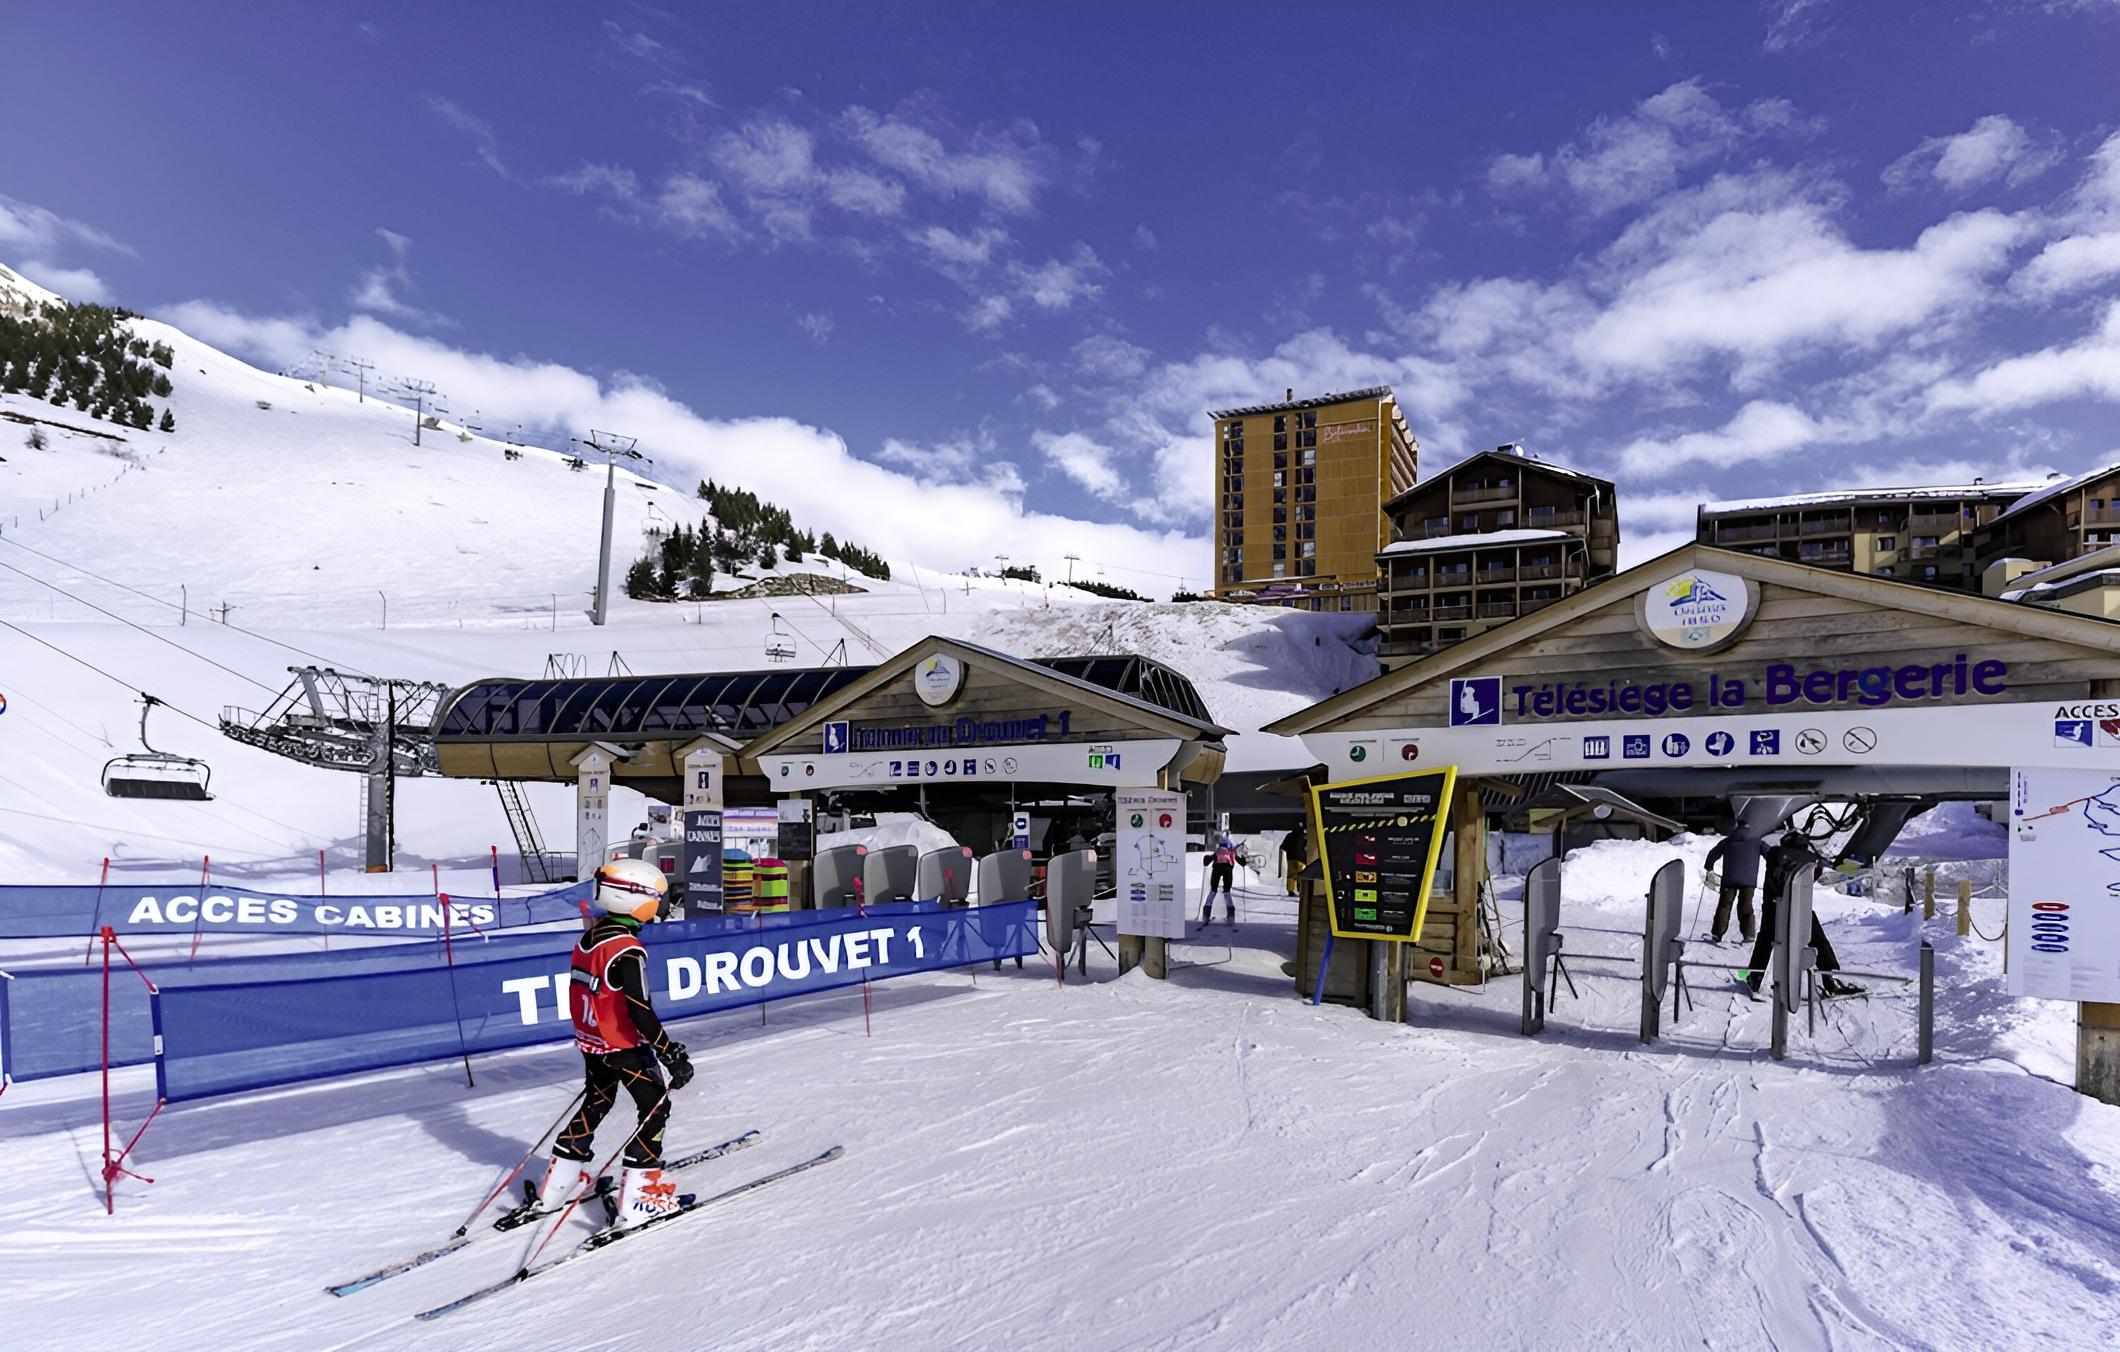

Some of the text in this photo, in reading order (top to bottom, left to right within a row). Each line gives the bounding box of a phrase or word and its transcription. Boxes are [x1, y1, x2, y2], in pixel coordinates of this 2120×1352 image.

[1709, 673, 1745, 708] la
[1765, 653, 2008, 706] Bergerie
[2054, 703, 2119, 719] ACCES
[128, 896, 495, 929] ACCES CABINES
[666, 927, 895, 1001] DROUVET
[907, 925, 924, 959] 1
